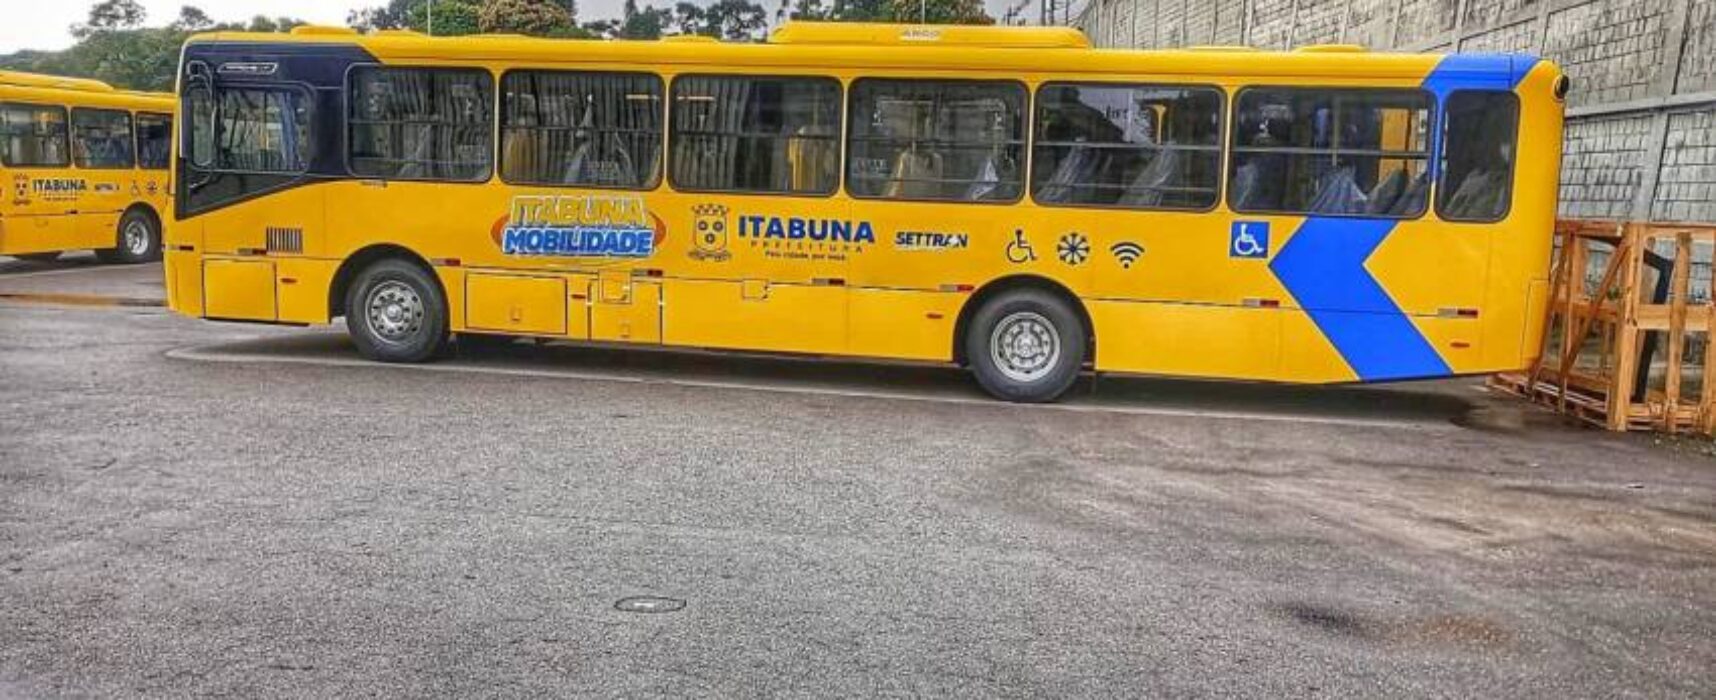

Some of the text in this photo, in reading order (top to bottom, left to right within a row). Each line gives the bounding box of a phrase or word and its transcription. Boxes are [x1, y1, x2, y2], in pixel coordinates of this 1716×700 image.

[33, 179, 87, 191] ITABUNA
[510, 196, 649, 227] ITABUNA
[503, 228, 655, 256] MOBILIDADE
[738, 216, 876, 244] ITABUNA
[895, 231, 968, 248] SETTRAN
